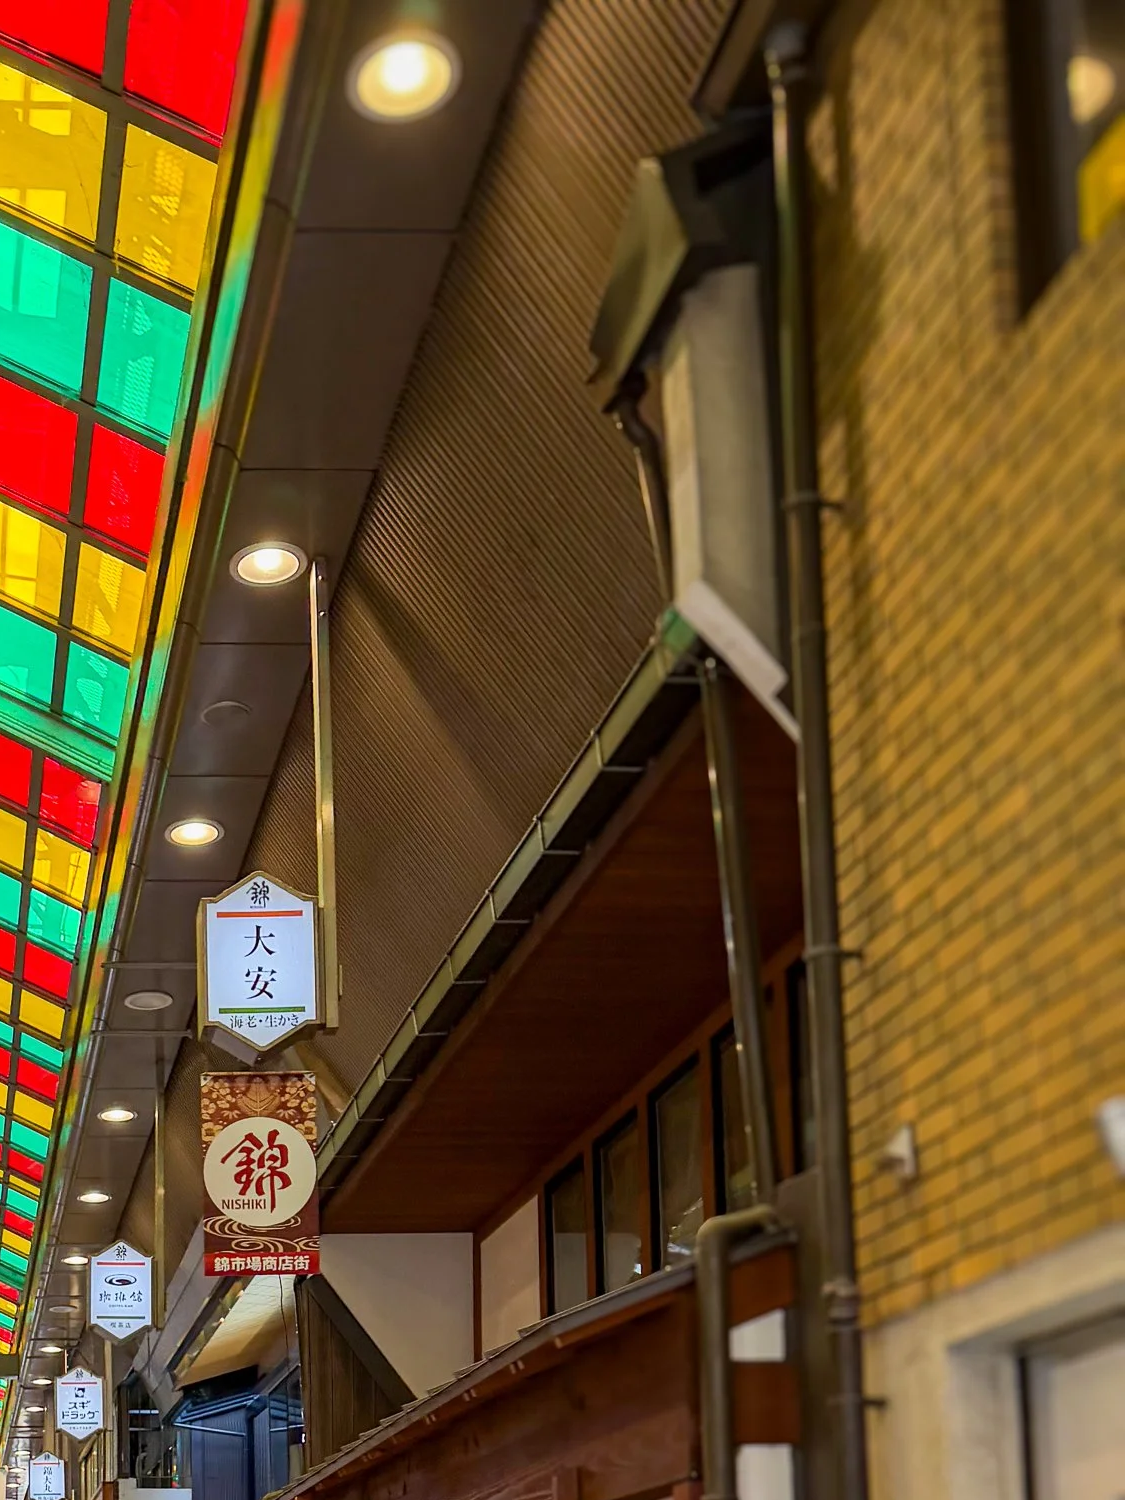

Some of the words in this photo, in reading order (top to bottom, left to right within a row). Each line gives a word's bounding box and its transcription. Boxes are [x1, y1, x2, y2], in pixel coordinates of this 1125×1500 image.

[246, 881, 270, 908] 錦
[244, 925, 277, 1000] 大安
[229, 1014, 300, 1029] 海老・生かき
[220, 1129, 292, 1213] 錦
[221, 1199, 266, 1210] NISHIKI
[214, 1256, 309, 1272] 錦市場商店街
[99, 1290, 143, 1303] 珈琲館
[68, 1400, 91, 1410] スギ
[62, 1411, 99, 1419] ドラッグ
